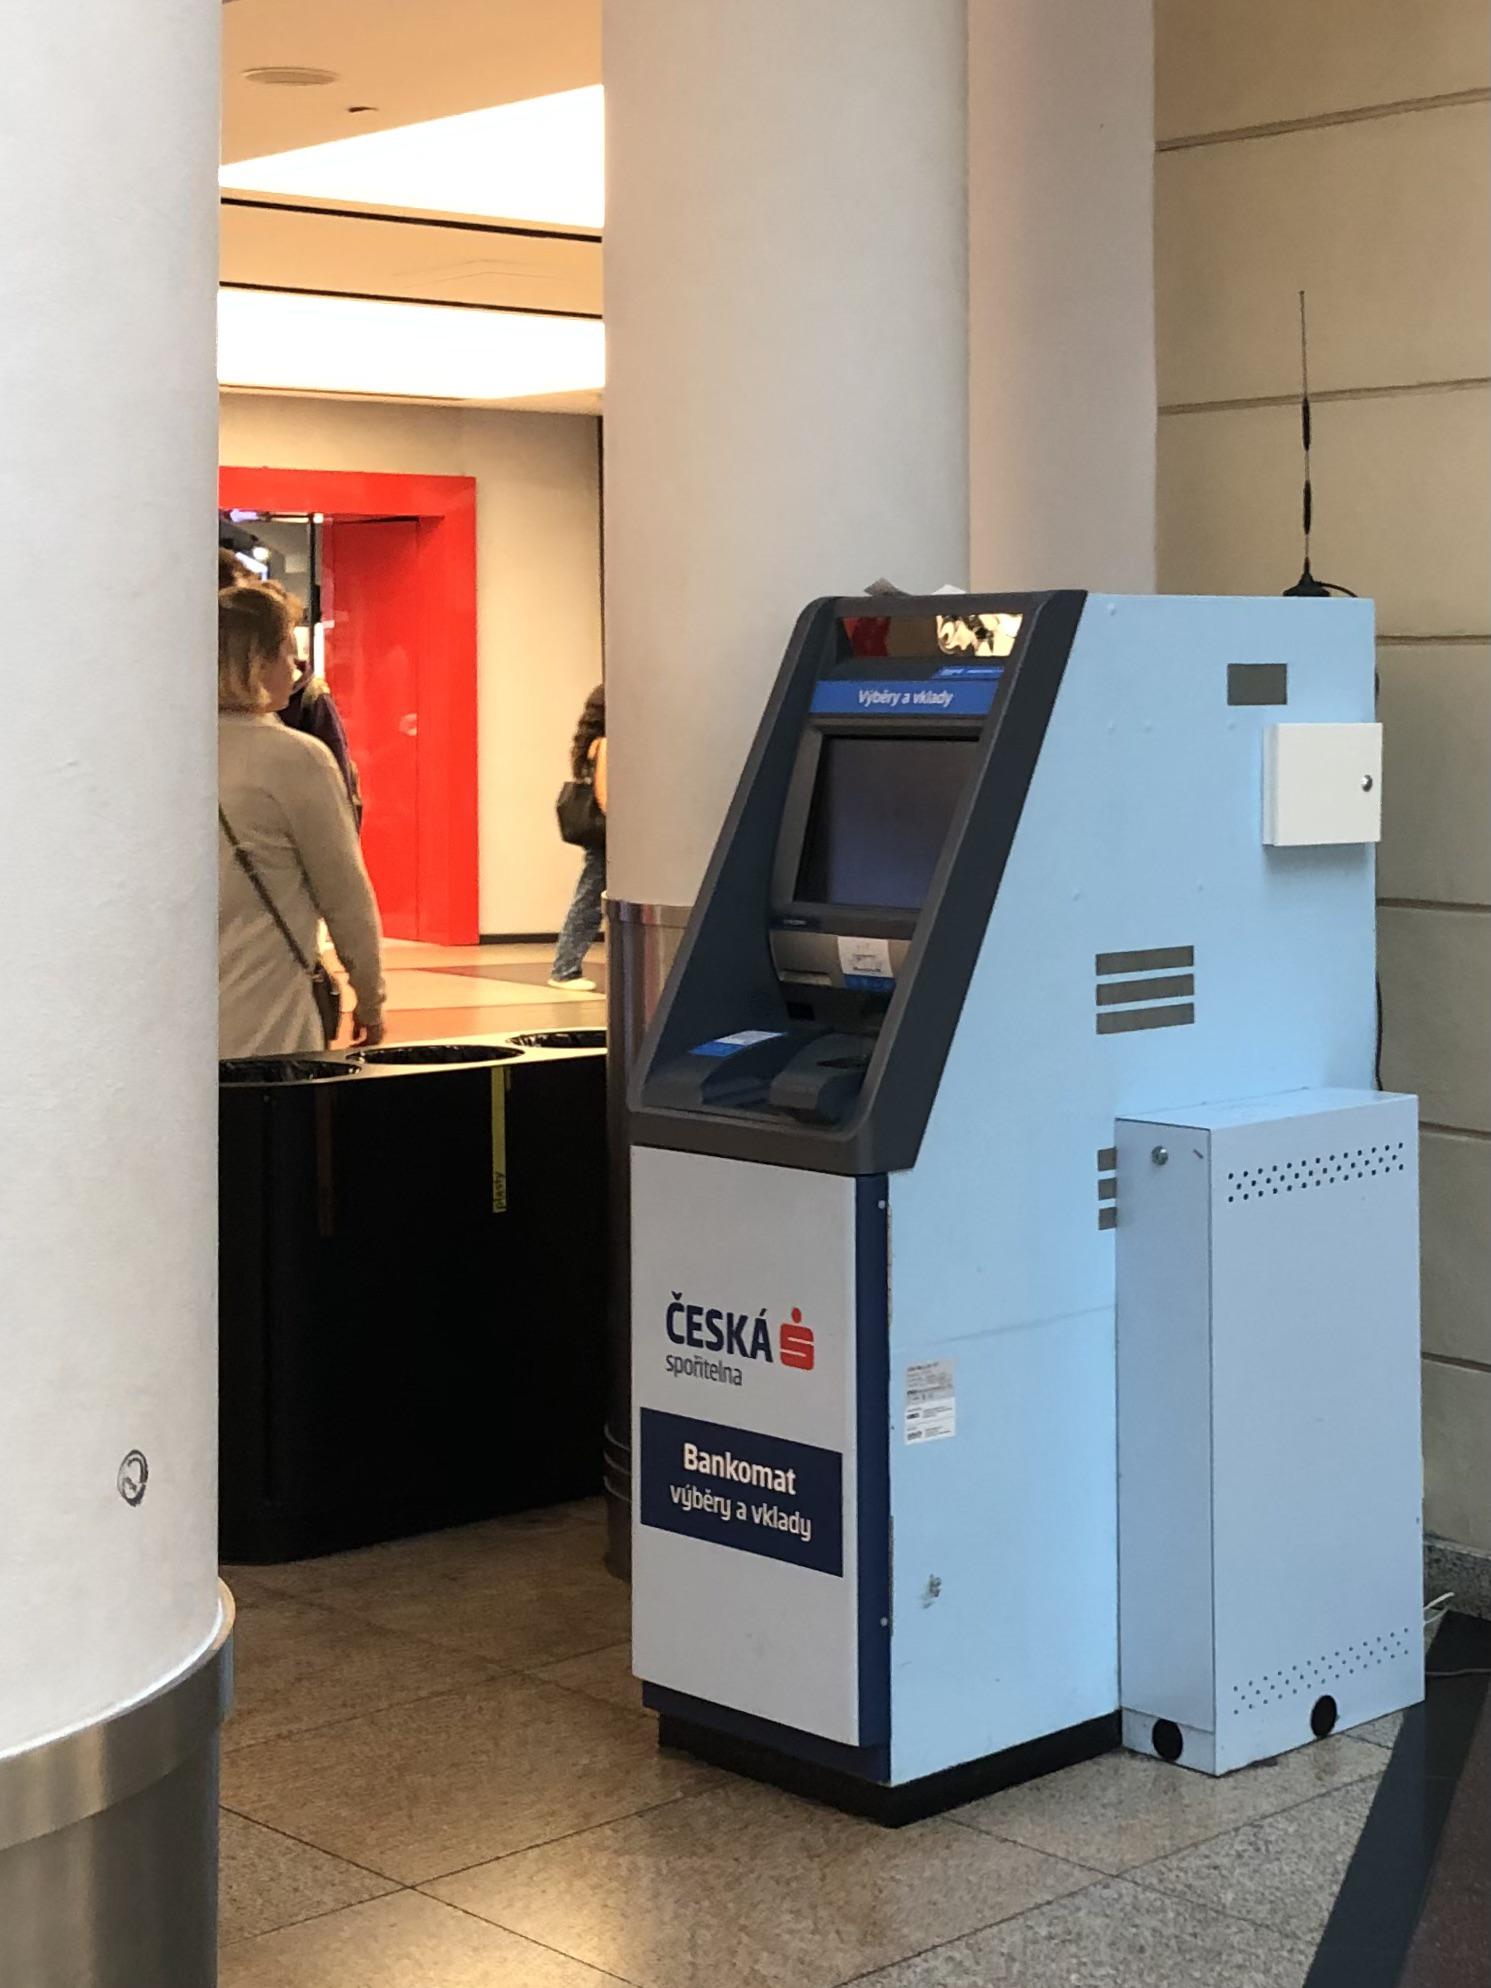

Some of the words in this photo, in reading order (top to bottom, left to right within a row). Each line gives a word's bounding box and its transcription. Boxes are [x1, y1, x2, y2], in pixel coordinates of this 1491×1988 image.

[858, 689, 900, 707] Výběry
[901, 693, 910, 703] a
[913, 690, 953, 707] vklady
[666, 1290, 774, 1363] ČESKÁ
[666, 1353, 743, 1386] spořitelna
[683, 1442, 797, 1496] Bankomat
[670, 1484, 731, 1521] výběry
[736, 1501, 748, 1520] a
[752, 1502, 812, 1542] vklady
